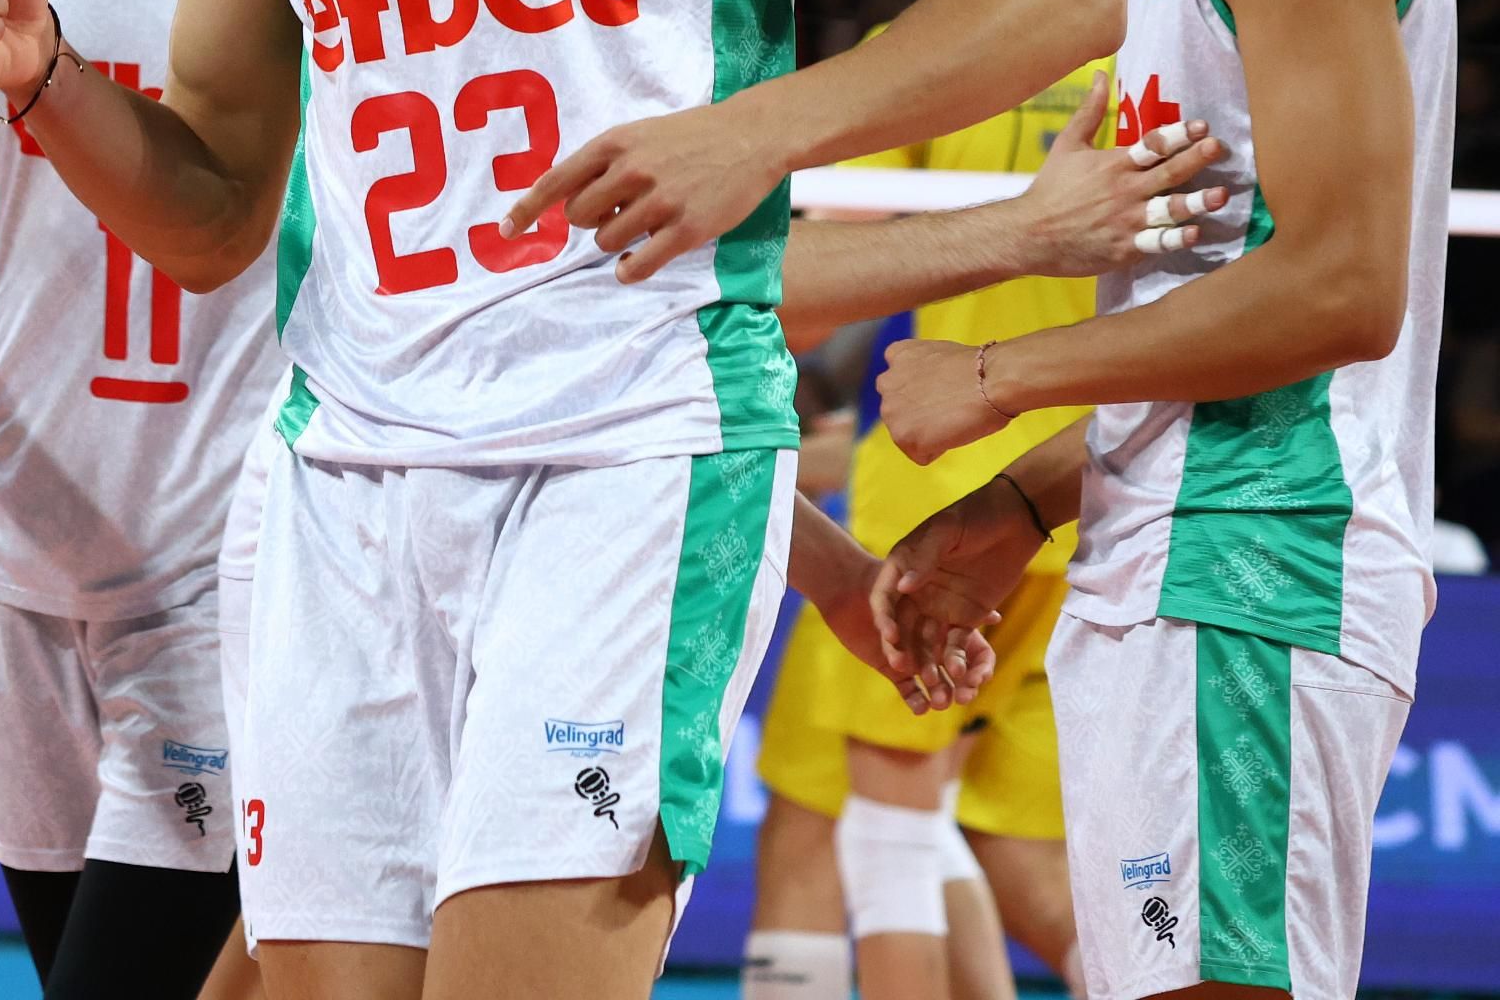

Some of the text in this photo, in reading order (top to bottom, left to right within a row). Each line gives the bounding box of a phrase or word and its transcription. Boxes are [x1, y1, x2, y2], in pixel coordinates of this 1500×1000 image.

[350, 69, 570, 295] 23
[544, 721, 624, 747] Velingrad
[241, 798, 265, 867] 3
[1119, 853, 1171, 882] Velingrad
